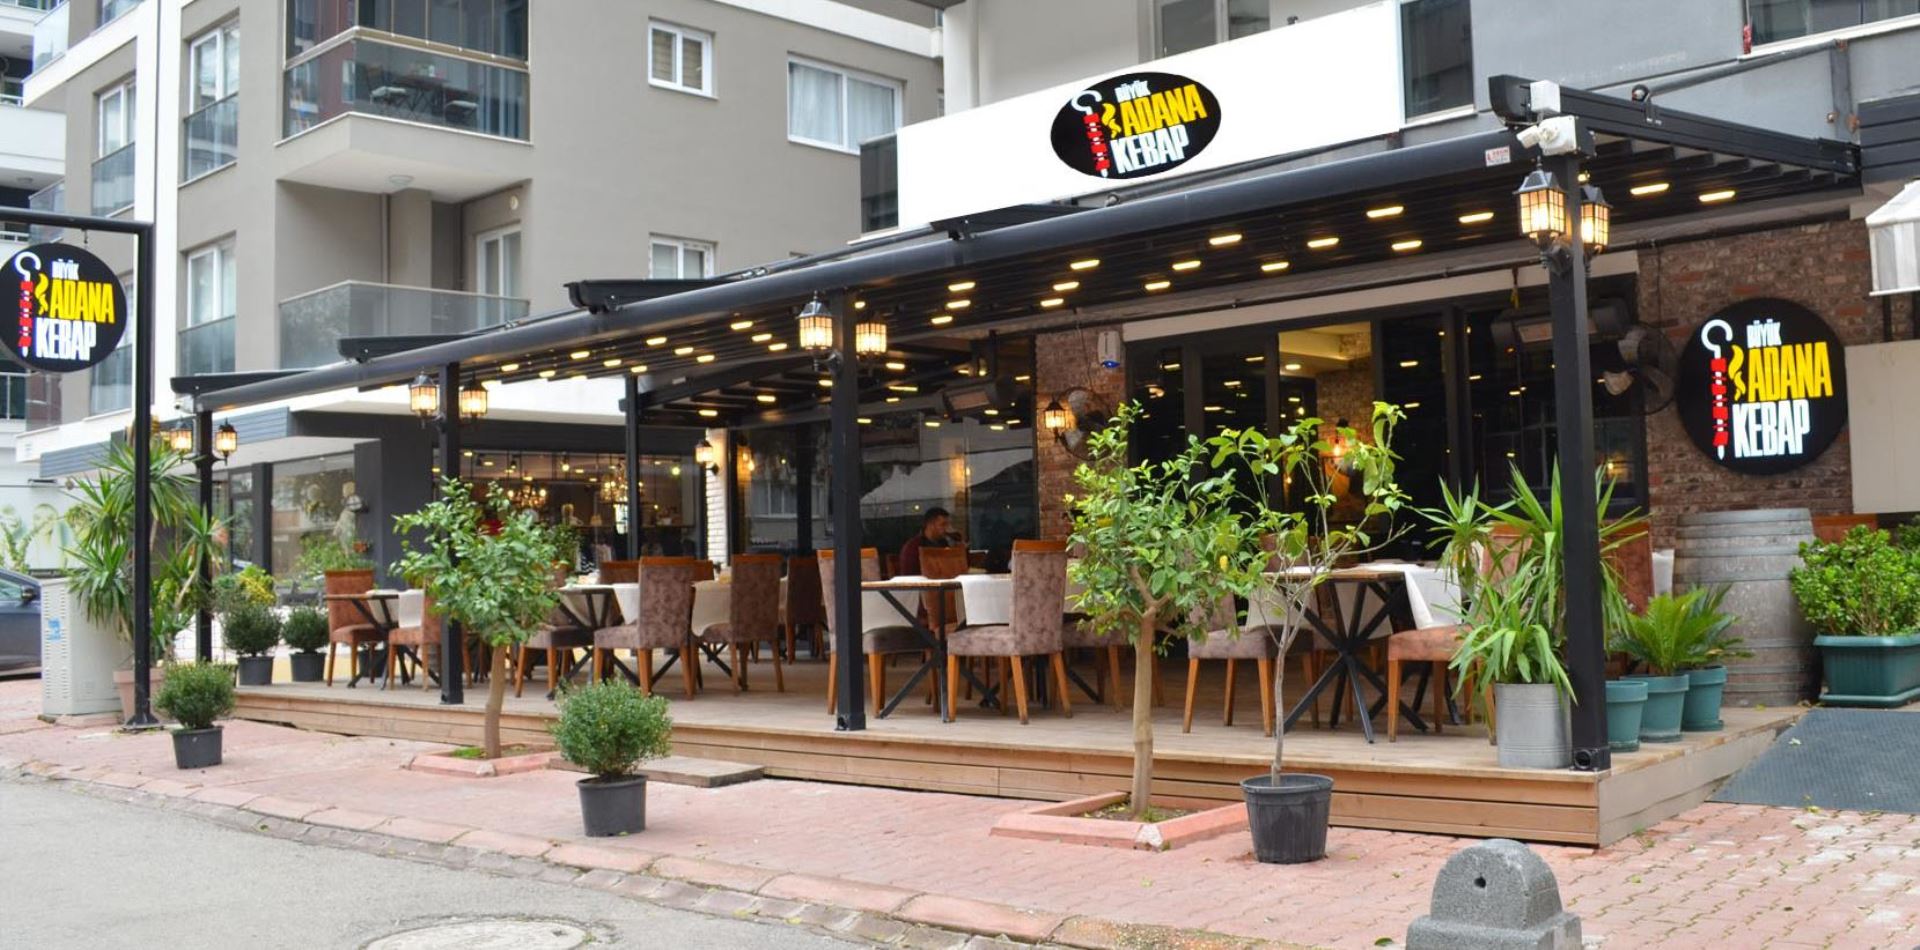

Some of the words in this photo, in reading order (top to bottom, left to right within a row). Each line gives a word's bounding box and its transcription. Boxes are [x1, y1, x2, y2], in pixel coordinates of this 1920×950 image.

[1120, 84, 1207, 136] ADANA
[1110, 125, 1189, 174] KEBAP
[49, 279, 115, 324] ADANA
[36, 317, 97, 361] KEBAP
[1746, 319, 1782, 348] BÜYÜK
[1748, 342, 1834, 402] ADANA
[1732, 399, 1811, 458] KEBAP
